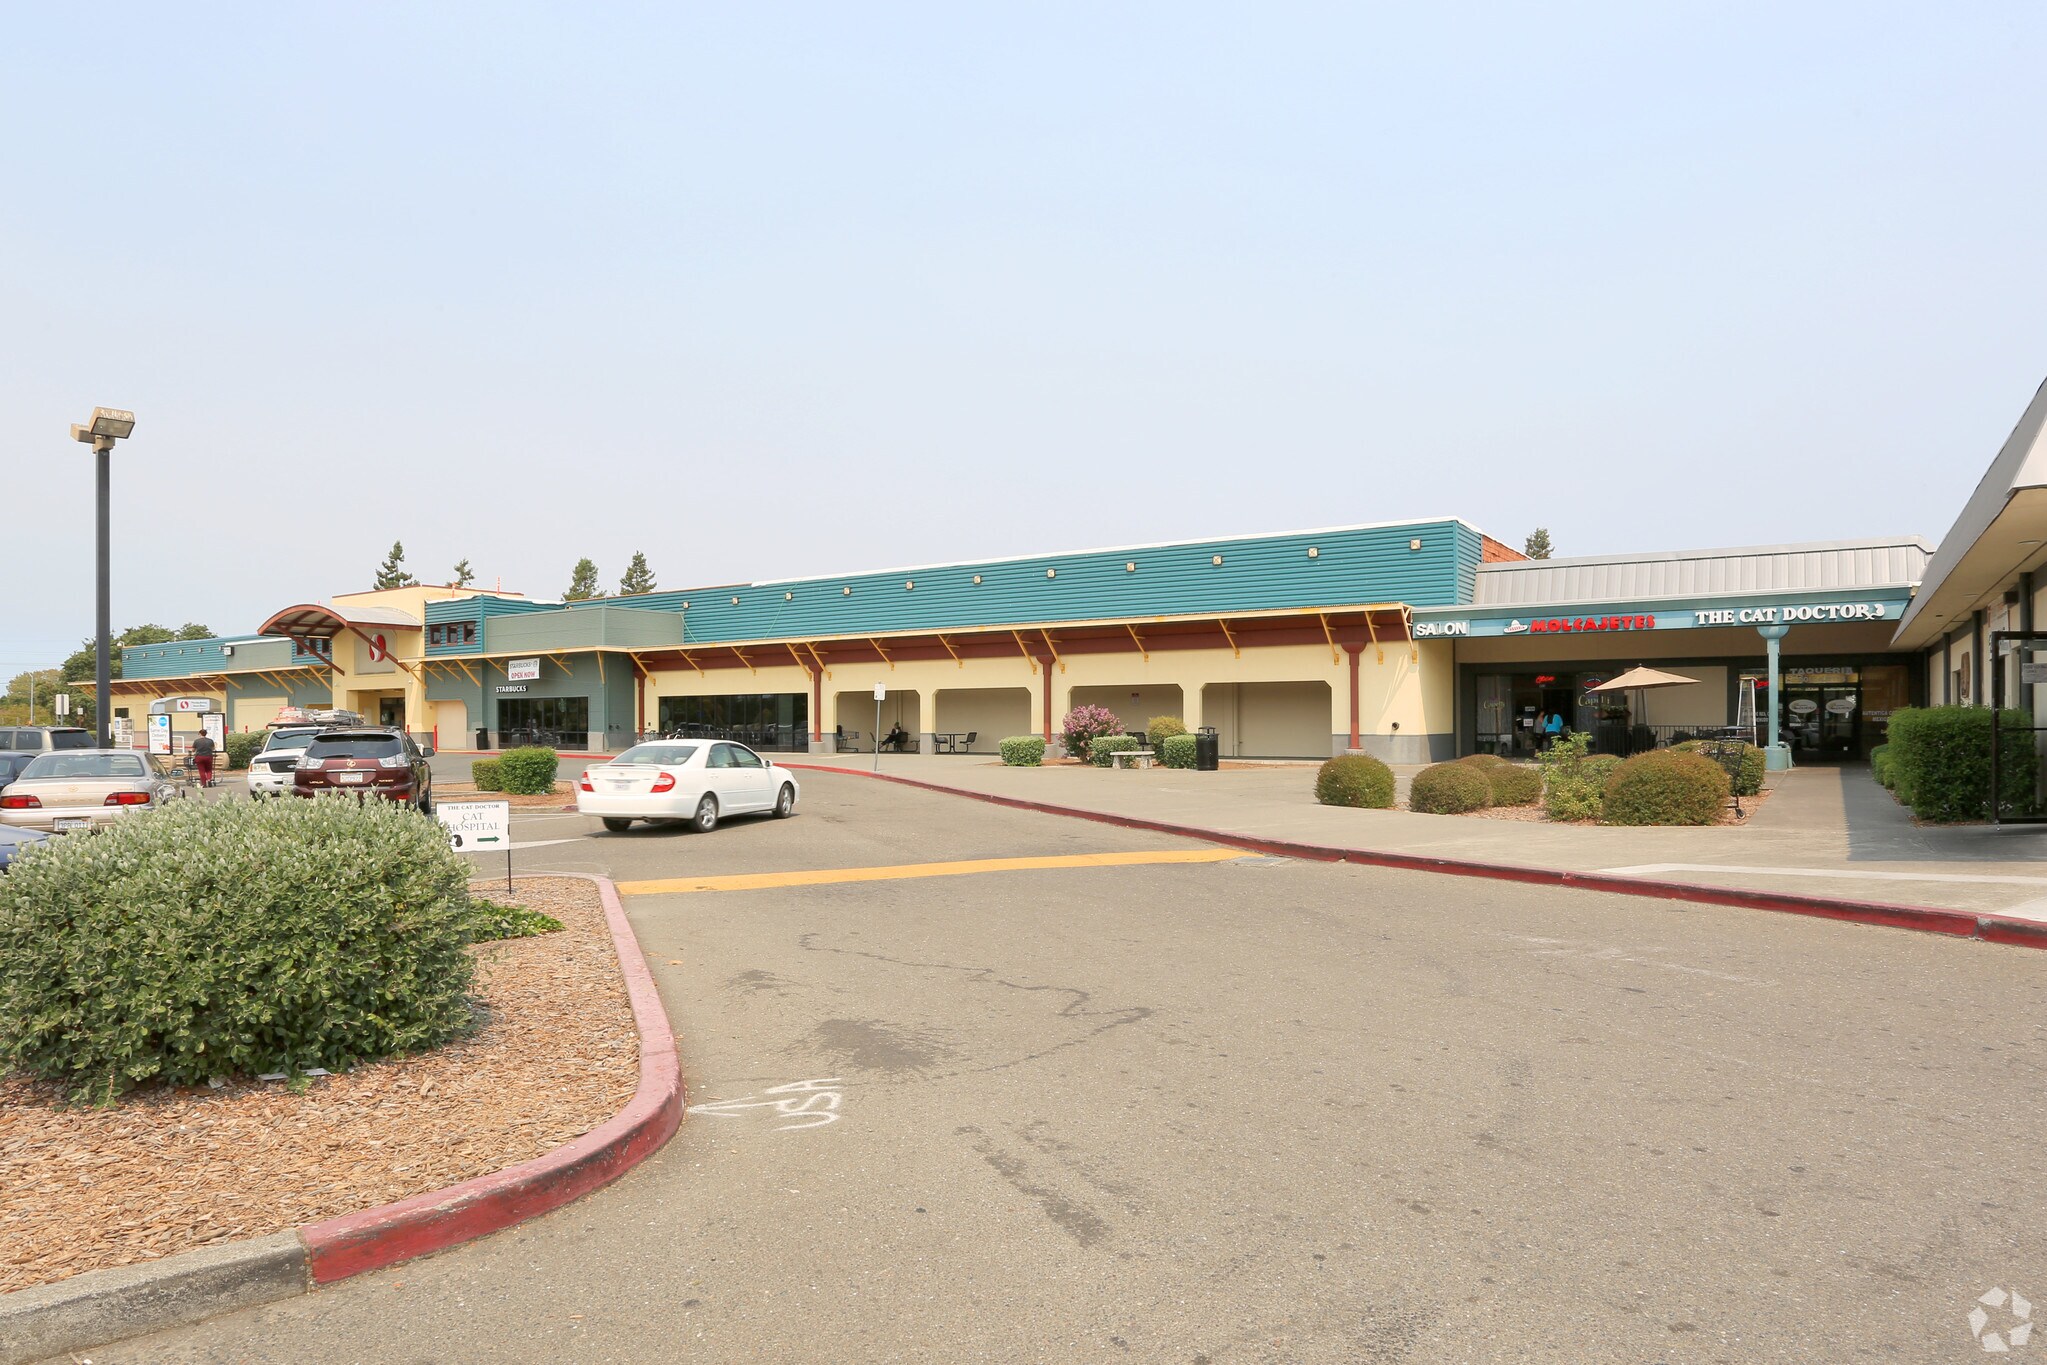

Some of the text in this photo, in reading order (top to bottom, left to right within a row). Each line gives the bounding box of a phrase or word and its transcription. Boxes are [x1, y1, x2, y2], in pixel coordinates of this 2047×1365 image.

[1695, 603, 1885, 625] THE CAT DOCTOR
[1416, 621, 1468, 637] SALON
[1529, 615, 1656, 633] MOLCAJETES
[495, 685, 527, 693] STARBUCKS
[462, 812, 485, 821] CAT
[447, 822, 500, 832] HOSPITAL
